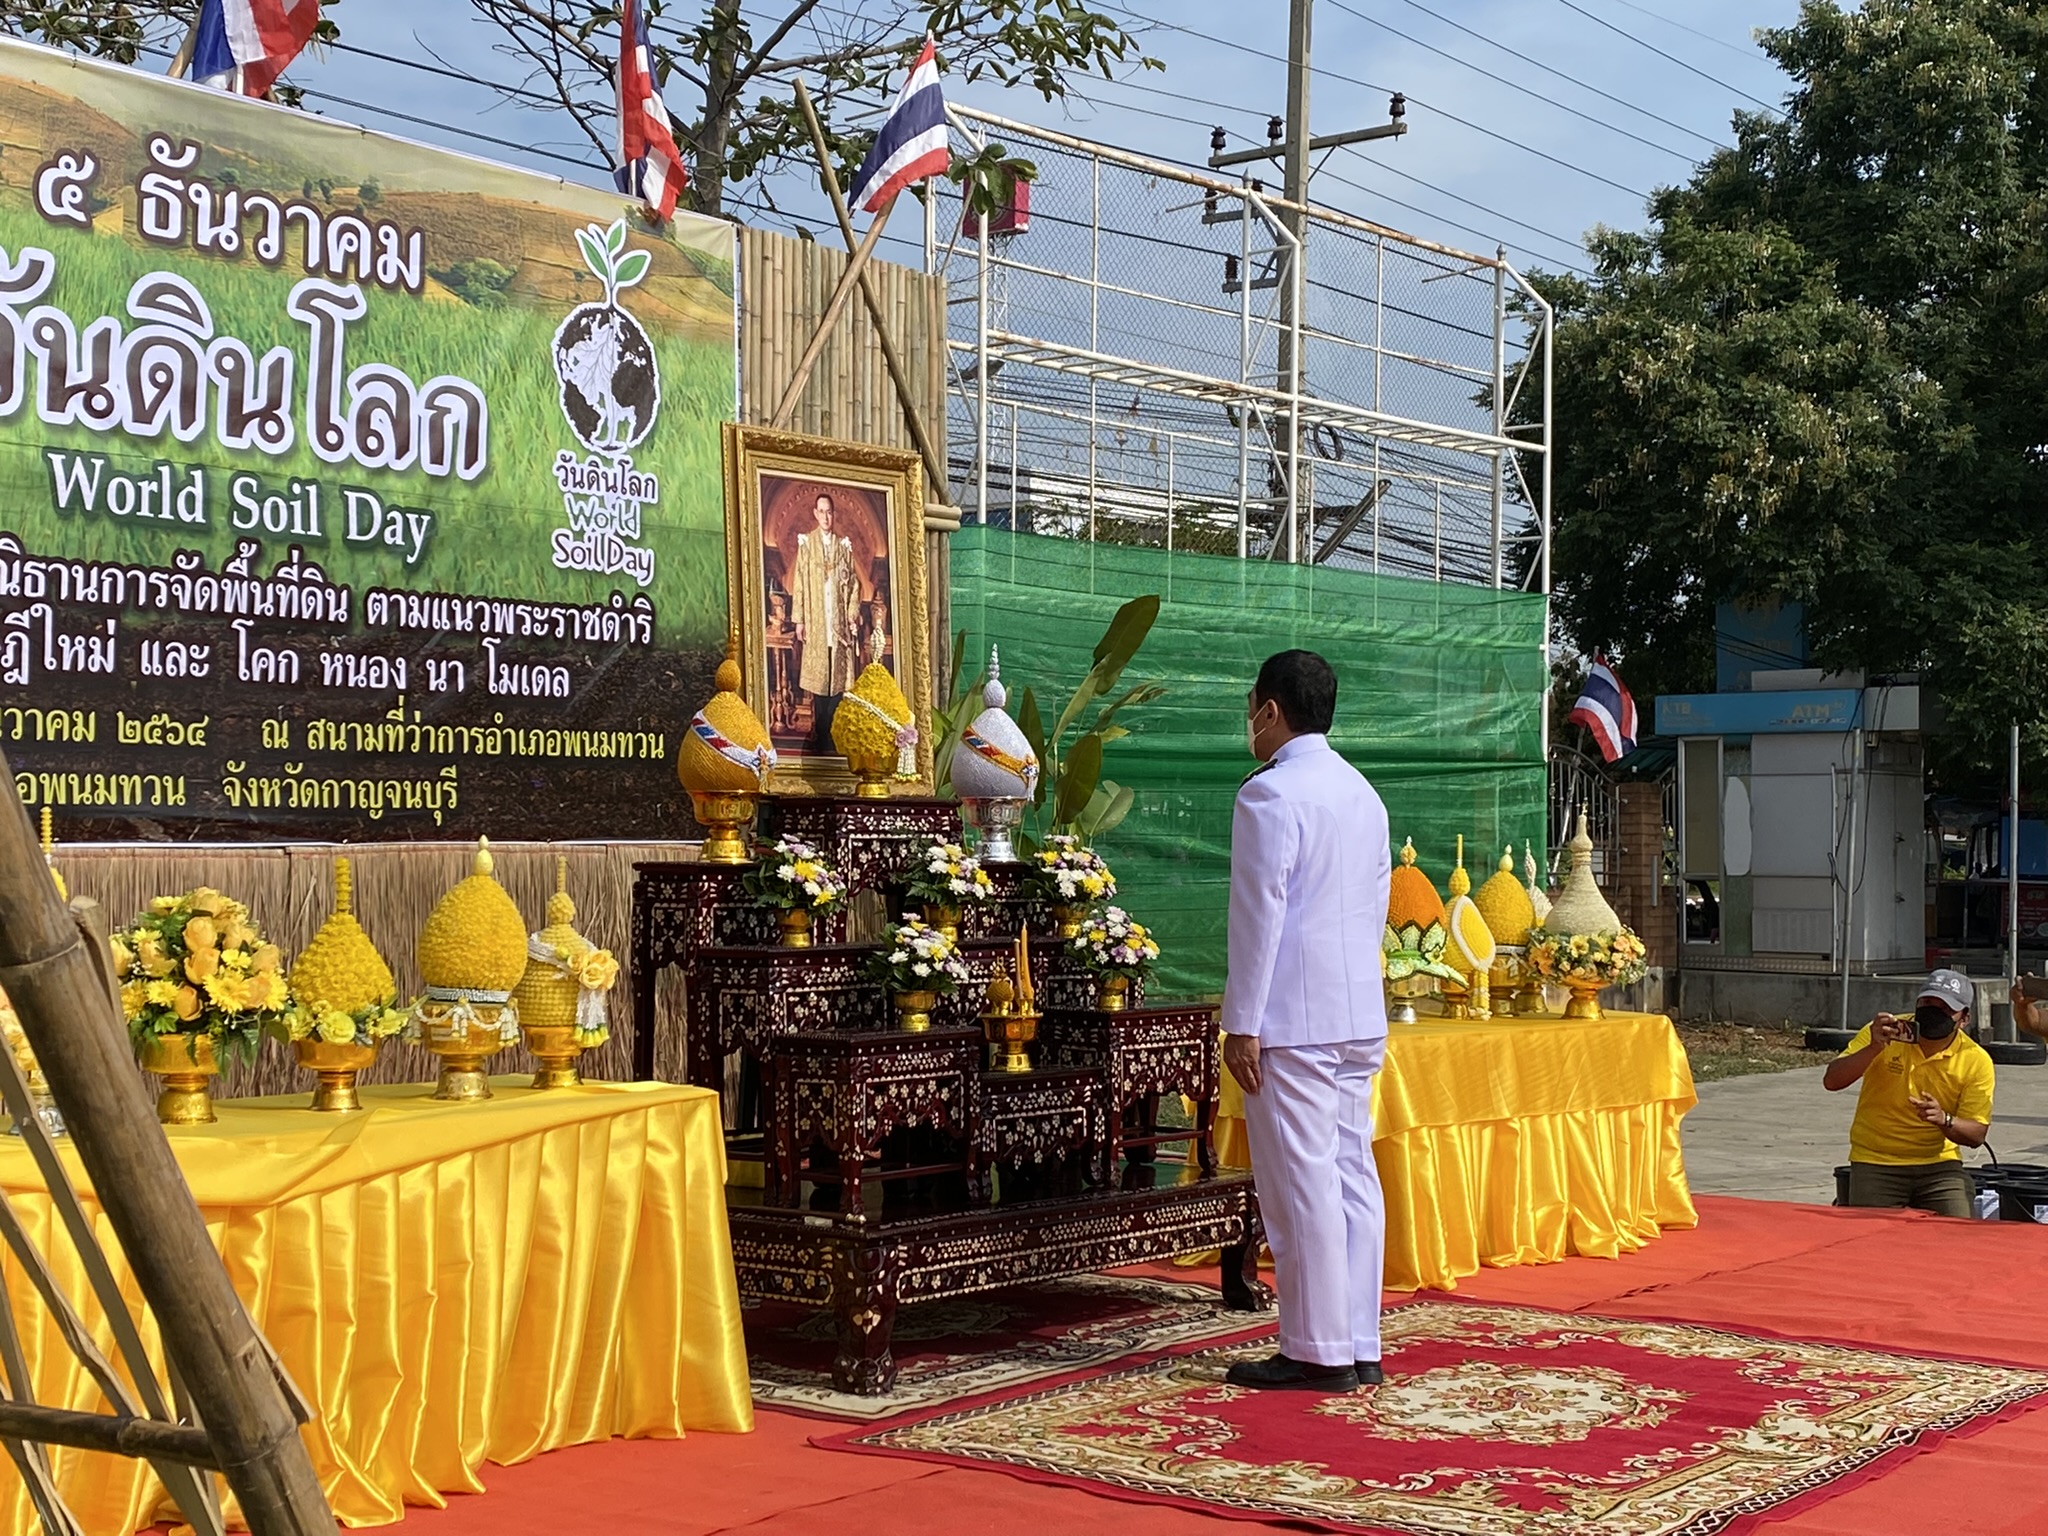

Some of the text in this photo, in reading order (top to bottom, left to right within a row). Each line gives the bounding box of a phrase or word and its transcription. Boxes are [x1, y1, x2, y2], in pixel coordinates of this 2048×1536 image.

[38, 137, 422, 290] ๕ ธันวาคม
[0, 250, 485, 477] ันดินโลก
[47, 452, 431, 564] World Soil Day
[556, 453, 656, 499] วันดินโลก
[566, 496, 638, 534] World
[554, 533, 652, 582] Soil Day
[367, 591, 653, 645] ตามแนวพระราชดำริ
[140, 638, 210, 678] และ
[231, 618, 299, 684] โคก
[320, 652, 407, 690] หนอง
[426, 658, 464, 693] นา
[481, 636, 571, 698] โมเดล
[0, 694, 666, 760] วาคม ๒๕๖๔ ณ สนามที่ว่าการอำเภอพนมทวน
[1791, 703, 1831, 719] ATM
[14, 760, 459, 827] อพนมทวน จังหวัดกาญจนบุรี
